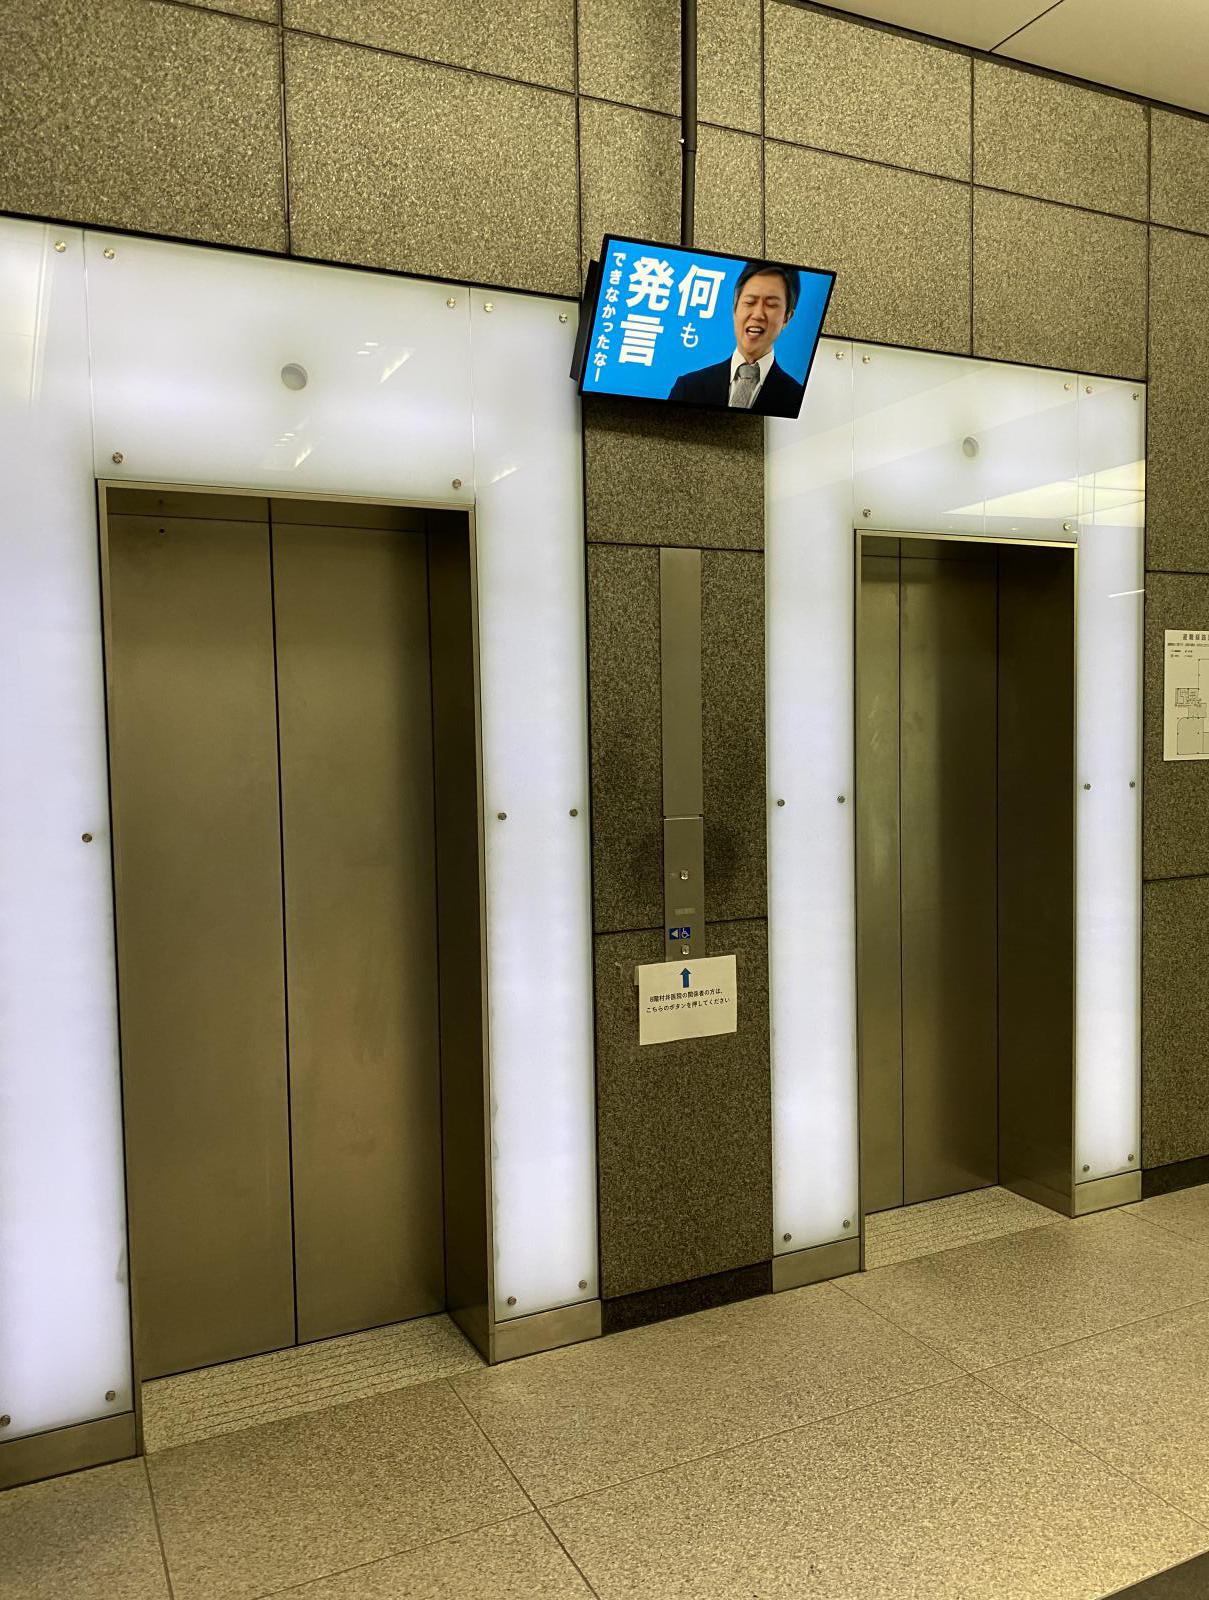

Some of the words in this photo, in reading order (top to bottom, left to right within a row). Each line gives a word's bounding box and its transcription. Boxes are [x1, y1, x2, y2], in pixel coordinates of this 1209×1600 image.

[593, 252, 627, 383] できなかったなー
[618, 256, 676, 367] 発言
[677, 264, 726, 348] 何も
